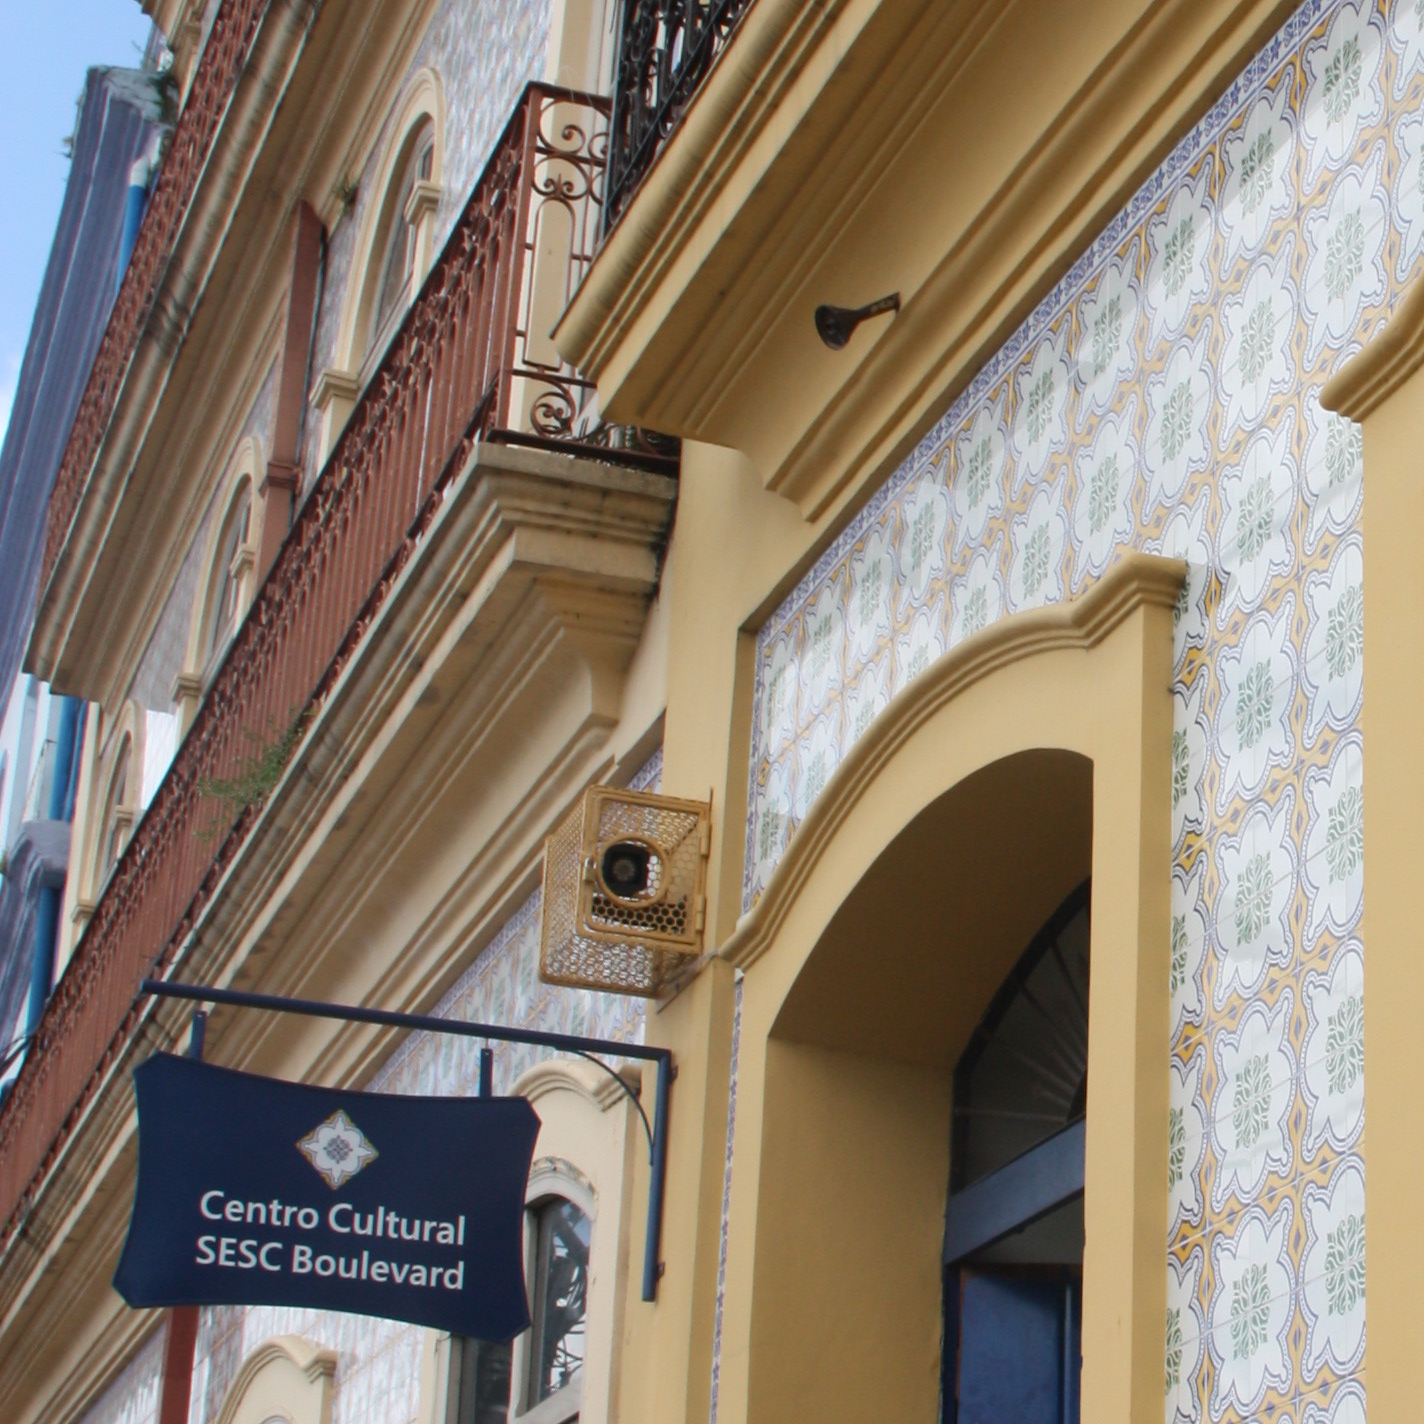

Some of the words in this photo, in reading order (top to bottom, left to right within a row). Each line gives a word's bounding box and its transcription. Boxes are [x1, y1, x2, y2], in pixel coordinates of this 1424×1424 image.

[200, 1190, 319, 1230] Centro
[327, 1202, 466, 1246] Cultural
[195, 1235, 283, 1272] SESC
[291, 1244, 465, 1290] Boulevard
